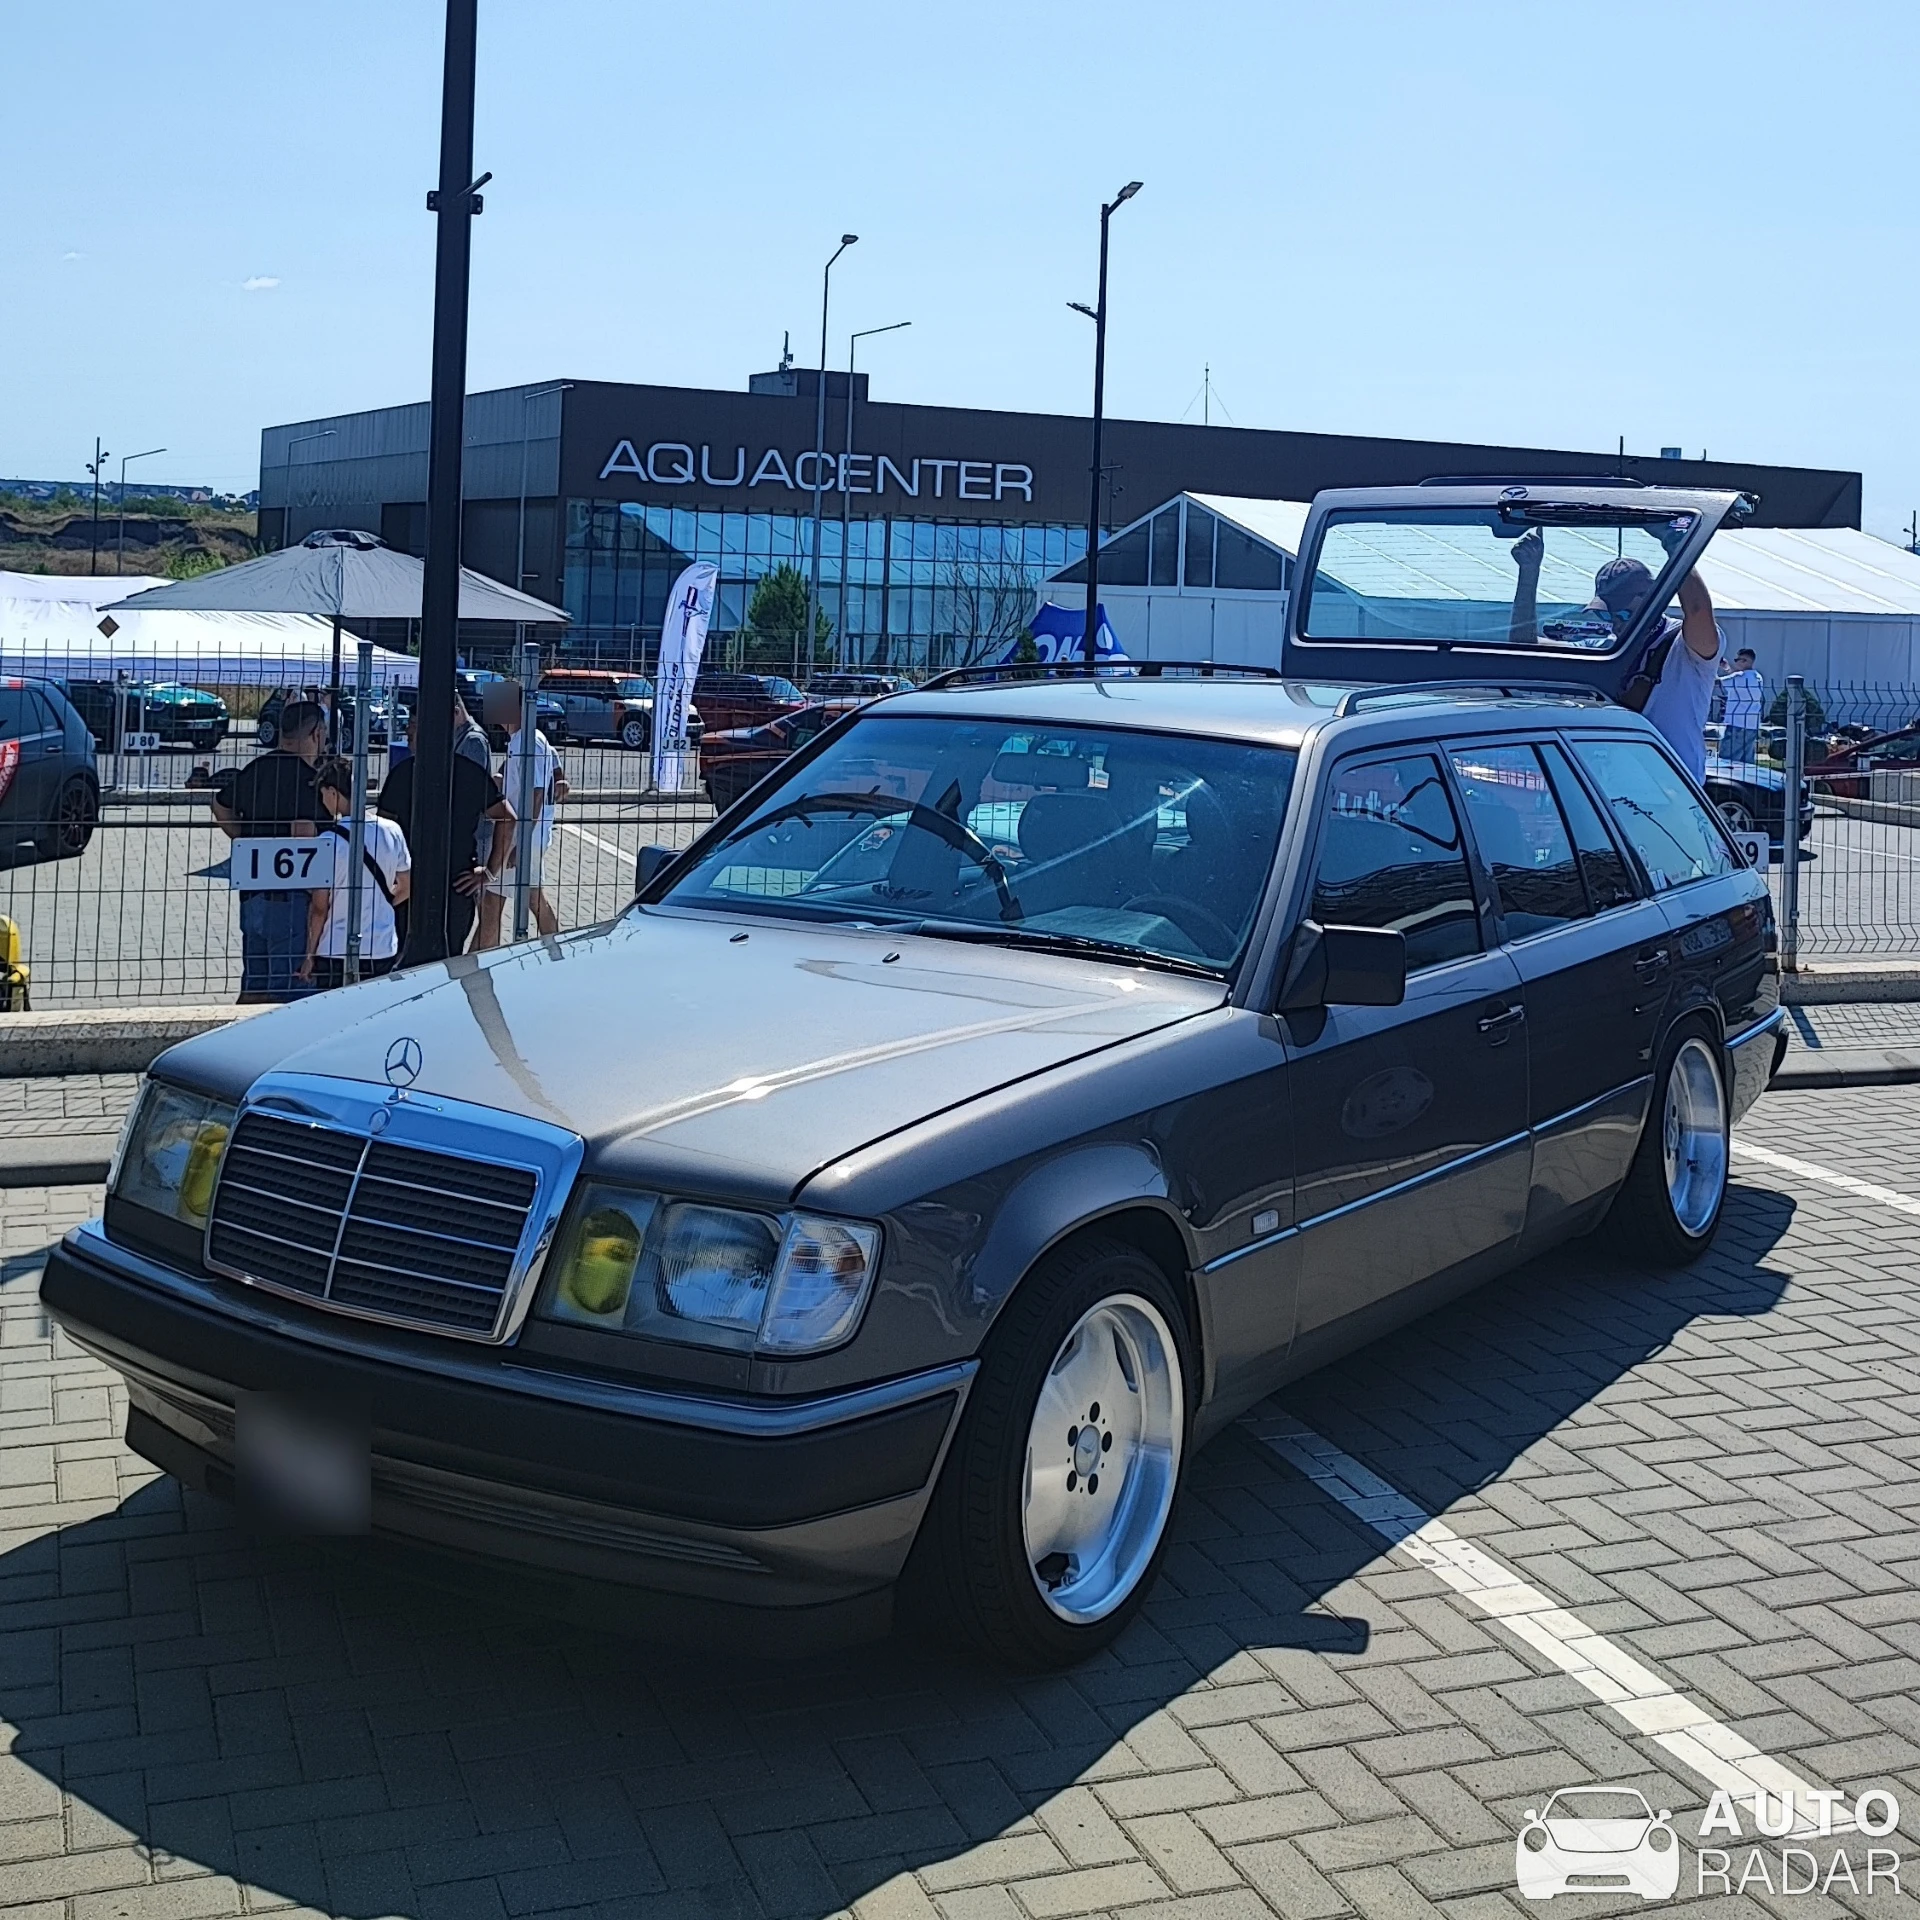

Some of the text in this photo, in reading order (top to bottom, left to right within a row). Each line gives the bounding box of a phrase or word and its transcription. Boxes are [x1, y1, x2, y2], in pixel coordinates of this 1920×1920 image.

[599, 440, 1033, 502] AQUACENTER
[668, 688, 682, 738] OLDOVA
[139, 735, 155, 747] 80
[662, 739, 687, 750] J 82
[250, 847, 318, 879] I 67
[1739, 840, 1759, 866] 9
